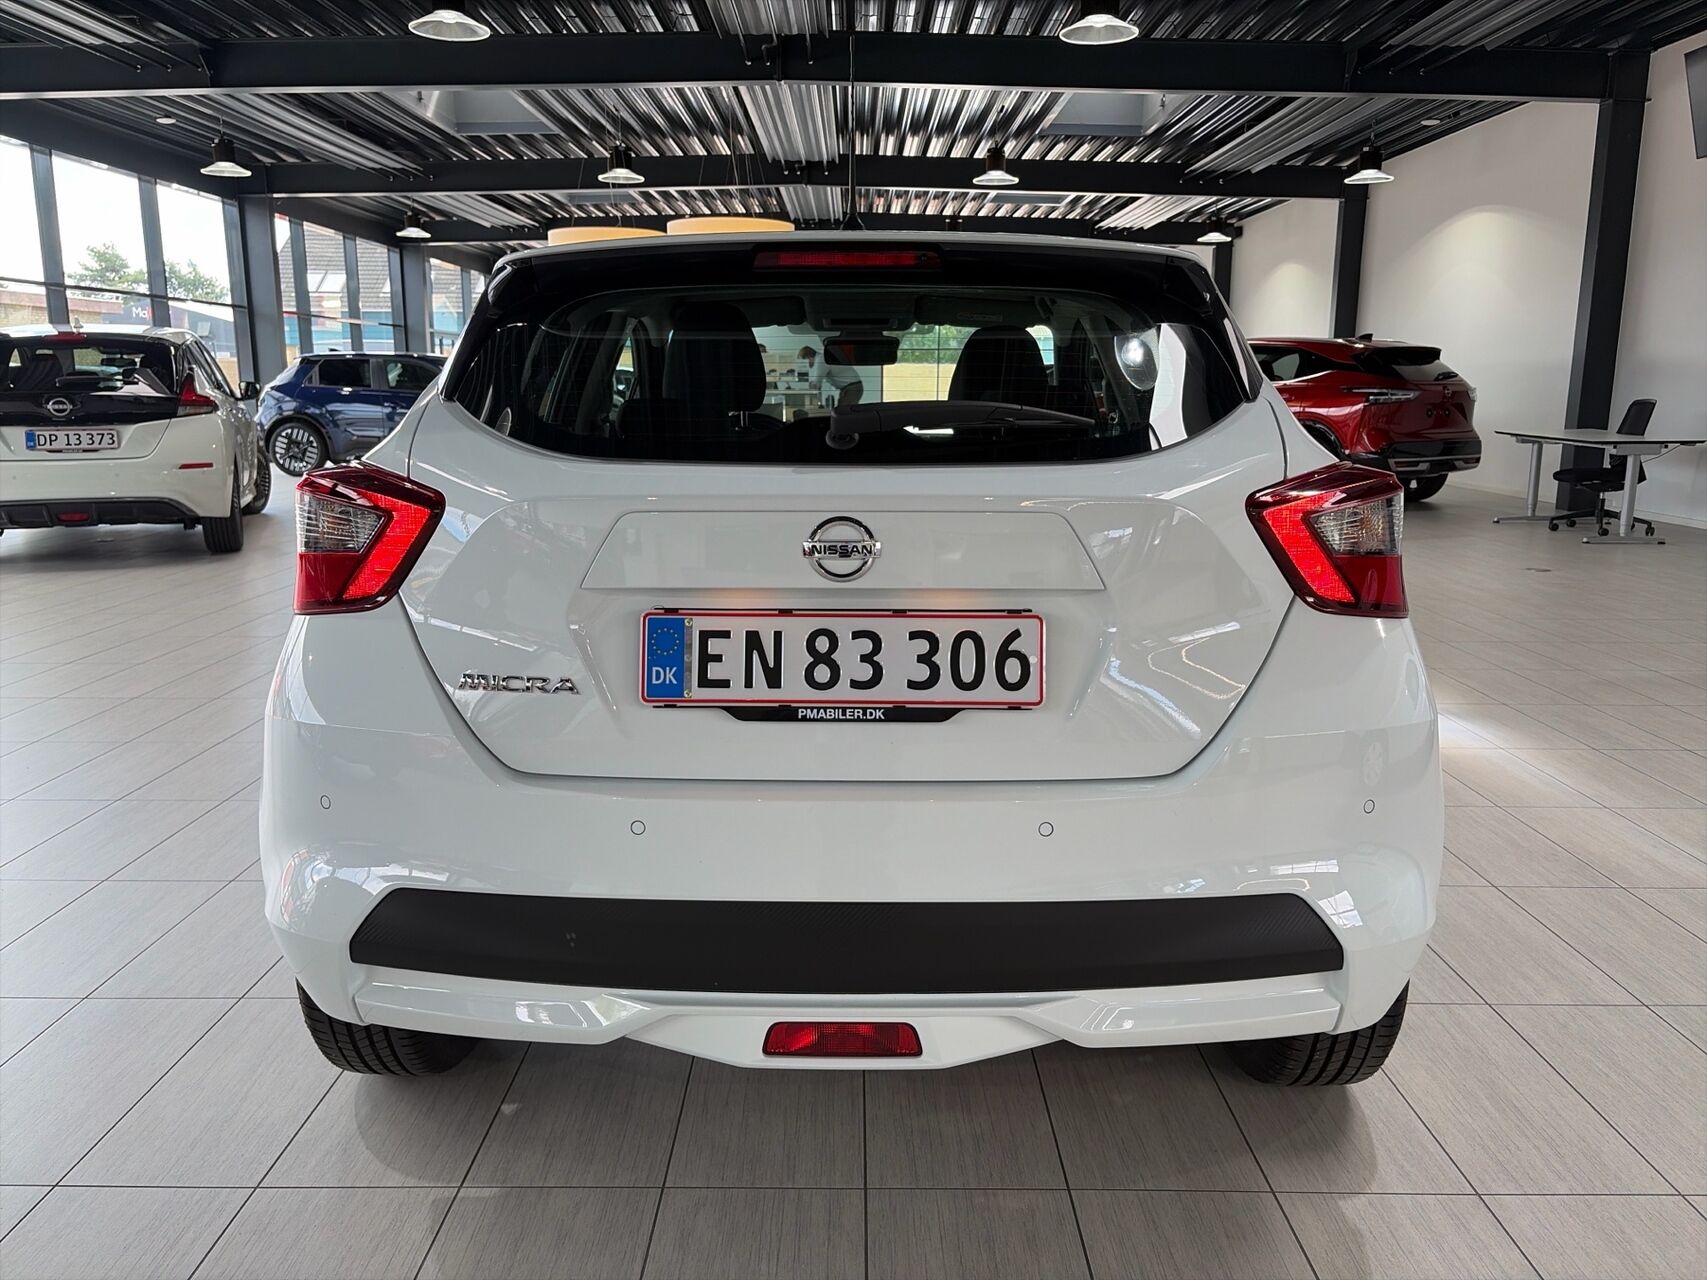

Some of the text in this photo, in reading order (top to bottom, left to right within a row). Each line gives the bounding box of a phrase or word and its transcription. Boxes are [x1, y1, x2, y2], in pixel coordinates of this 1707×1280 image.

[36, 432, 115, 447] DP 13 373
[811, 544, 873, 555] NISSAN
[697, 627, 1031, 692] EN 83 306
[651, 666, 678, 684] DK
[459, 673, 580, 695] MICRA
[798, 708, 885, 720] PMABILER.DK
